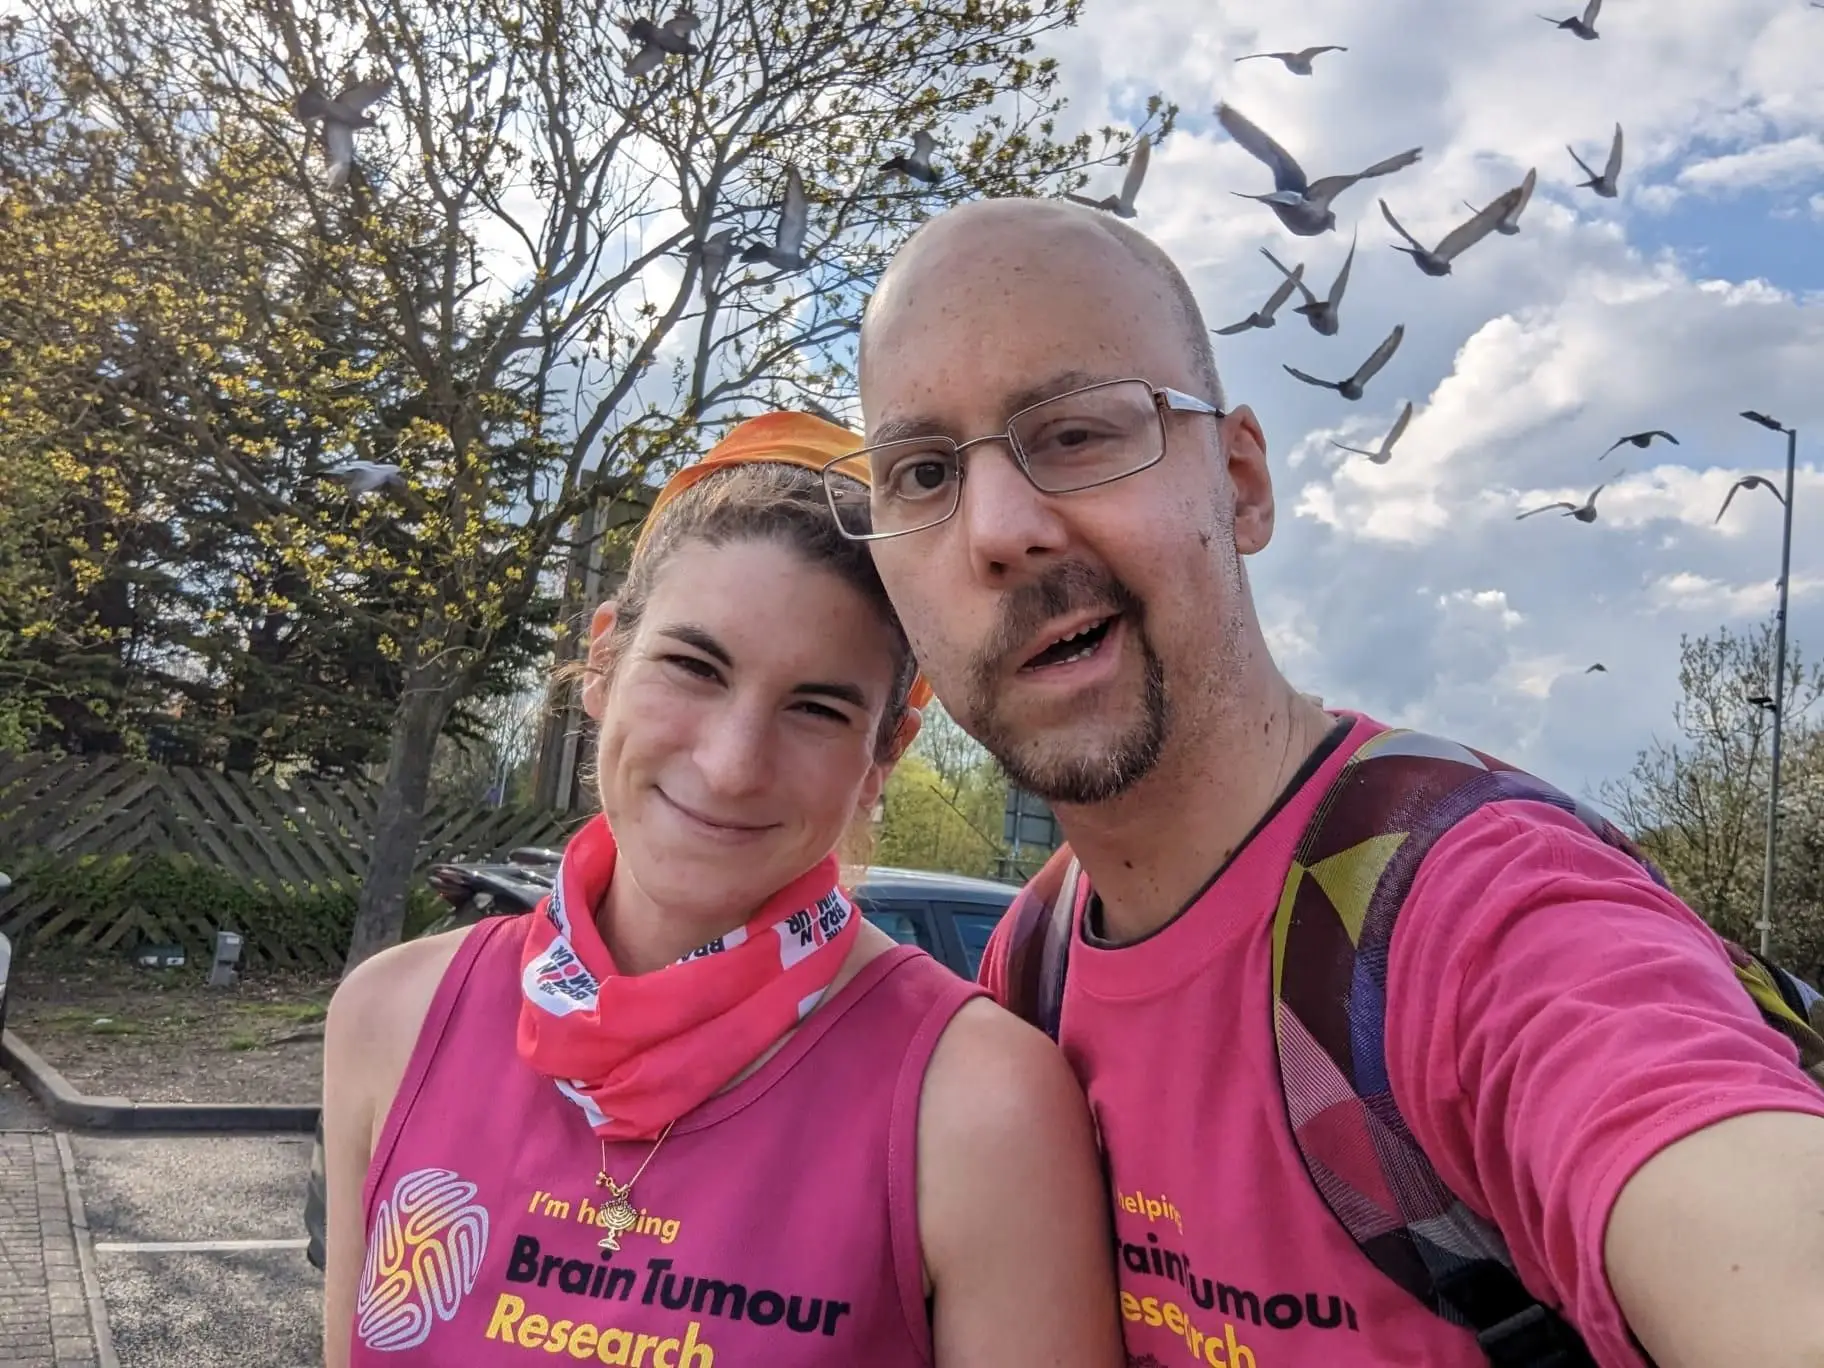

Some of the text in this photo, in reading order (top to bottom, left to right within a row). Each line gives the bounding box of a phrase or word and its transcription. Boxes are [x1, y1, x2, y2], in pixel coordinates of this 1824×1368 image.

[528, 1190, 569, 1219] I'm
[506, 1234, 850, 1336] Brain Tumour
[485, 1292, 715, 1368] Research
[1120, 1290, 1257, 1368] eserch
